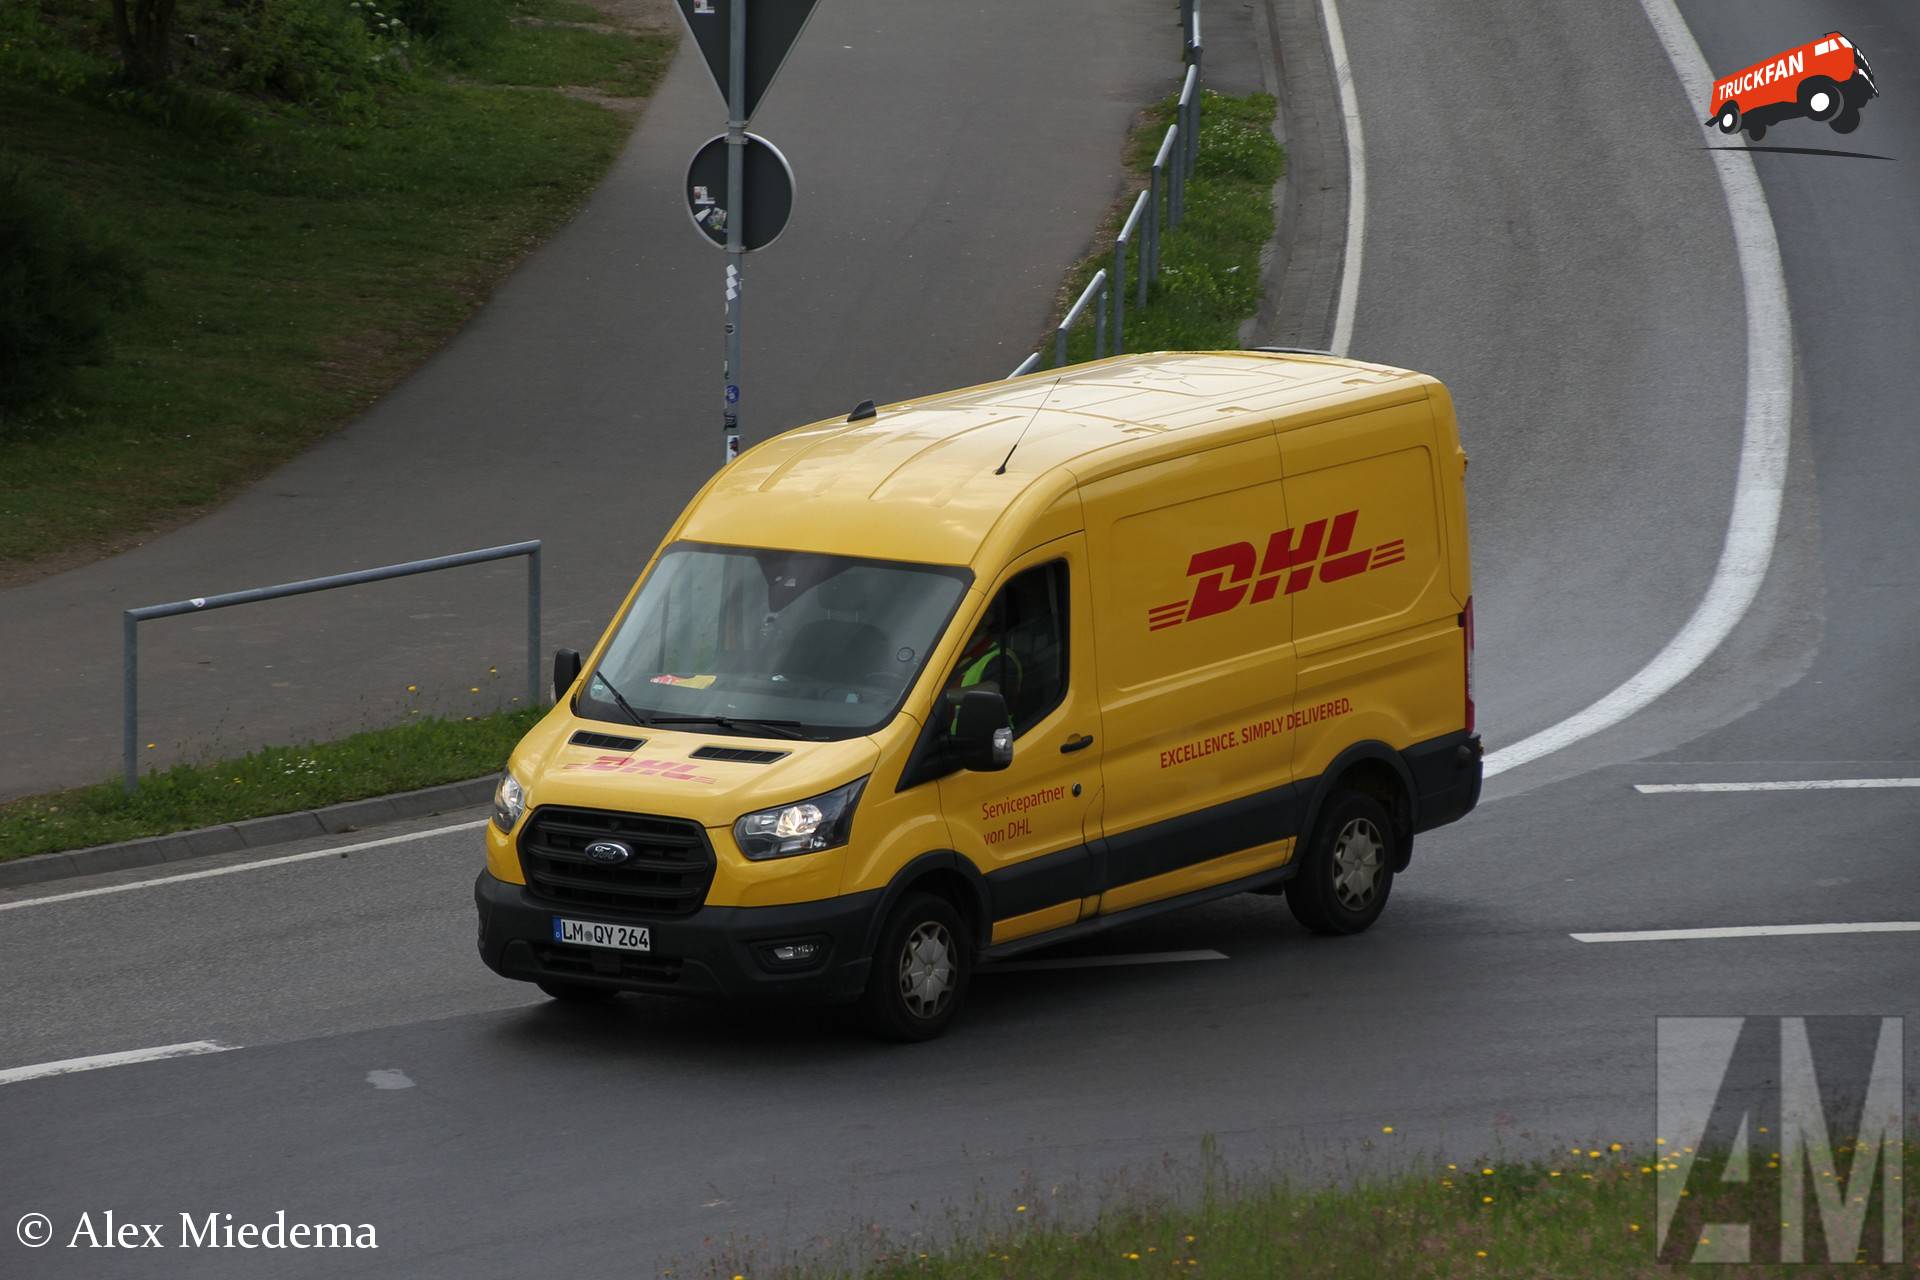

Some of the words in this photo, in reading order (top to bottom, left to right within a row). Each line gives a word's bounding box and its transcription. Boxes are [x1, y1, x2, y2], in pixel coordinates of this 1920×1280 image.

[1185, 509, 1373, 622] DHL
[1160, 731, 1240, 769] EXCELLENCE.
[1241, 716, 1285, 745] SIMPLY
[1286, 697, 1353, 731] DELIVERED.
[584, 756, 699, 780] DHL
[982, 785, 1065, 821] Servicepartner
[983, 828, 1005, 846] von
[1007, 818, 1033, 839] DHL
[593, 845, 617, 860] Ford
[562, 921, 584, 942] LM
[594, 925, 614, 945] QY
[618, 927, 649, 949] 264
